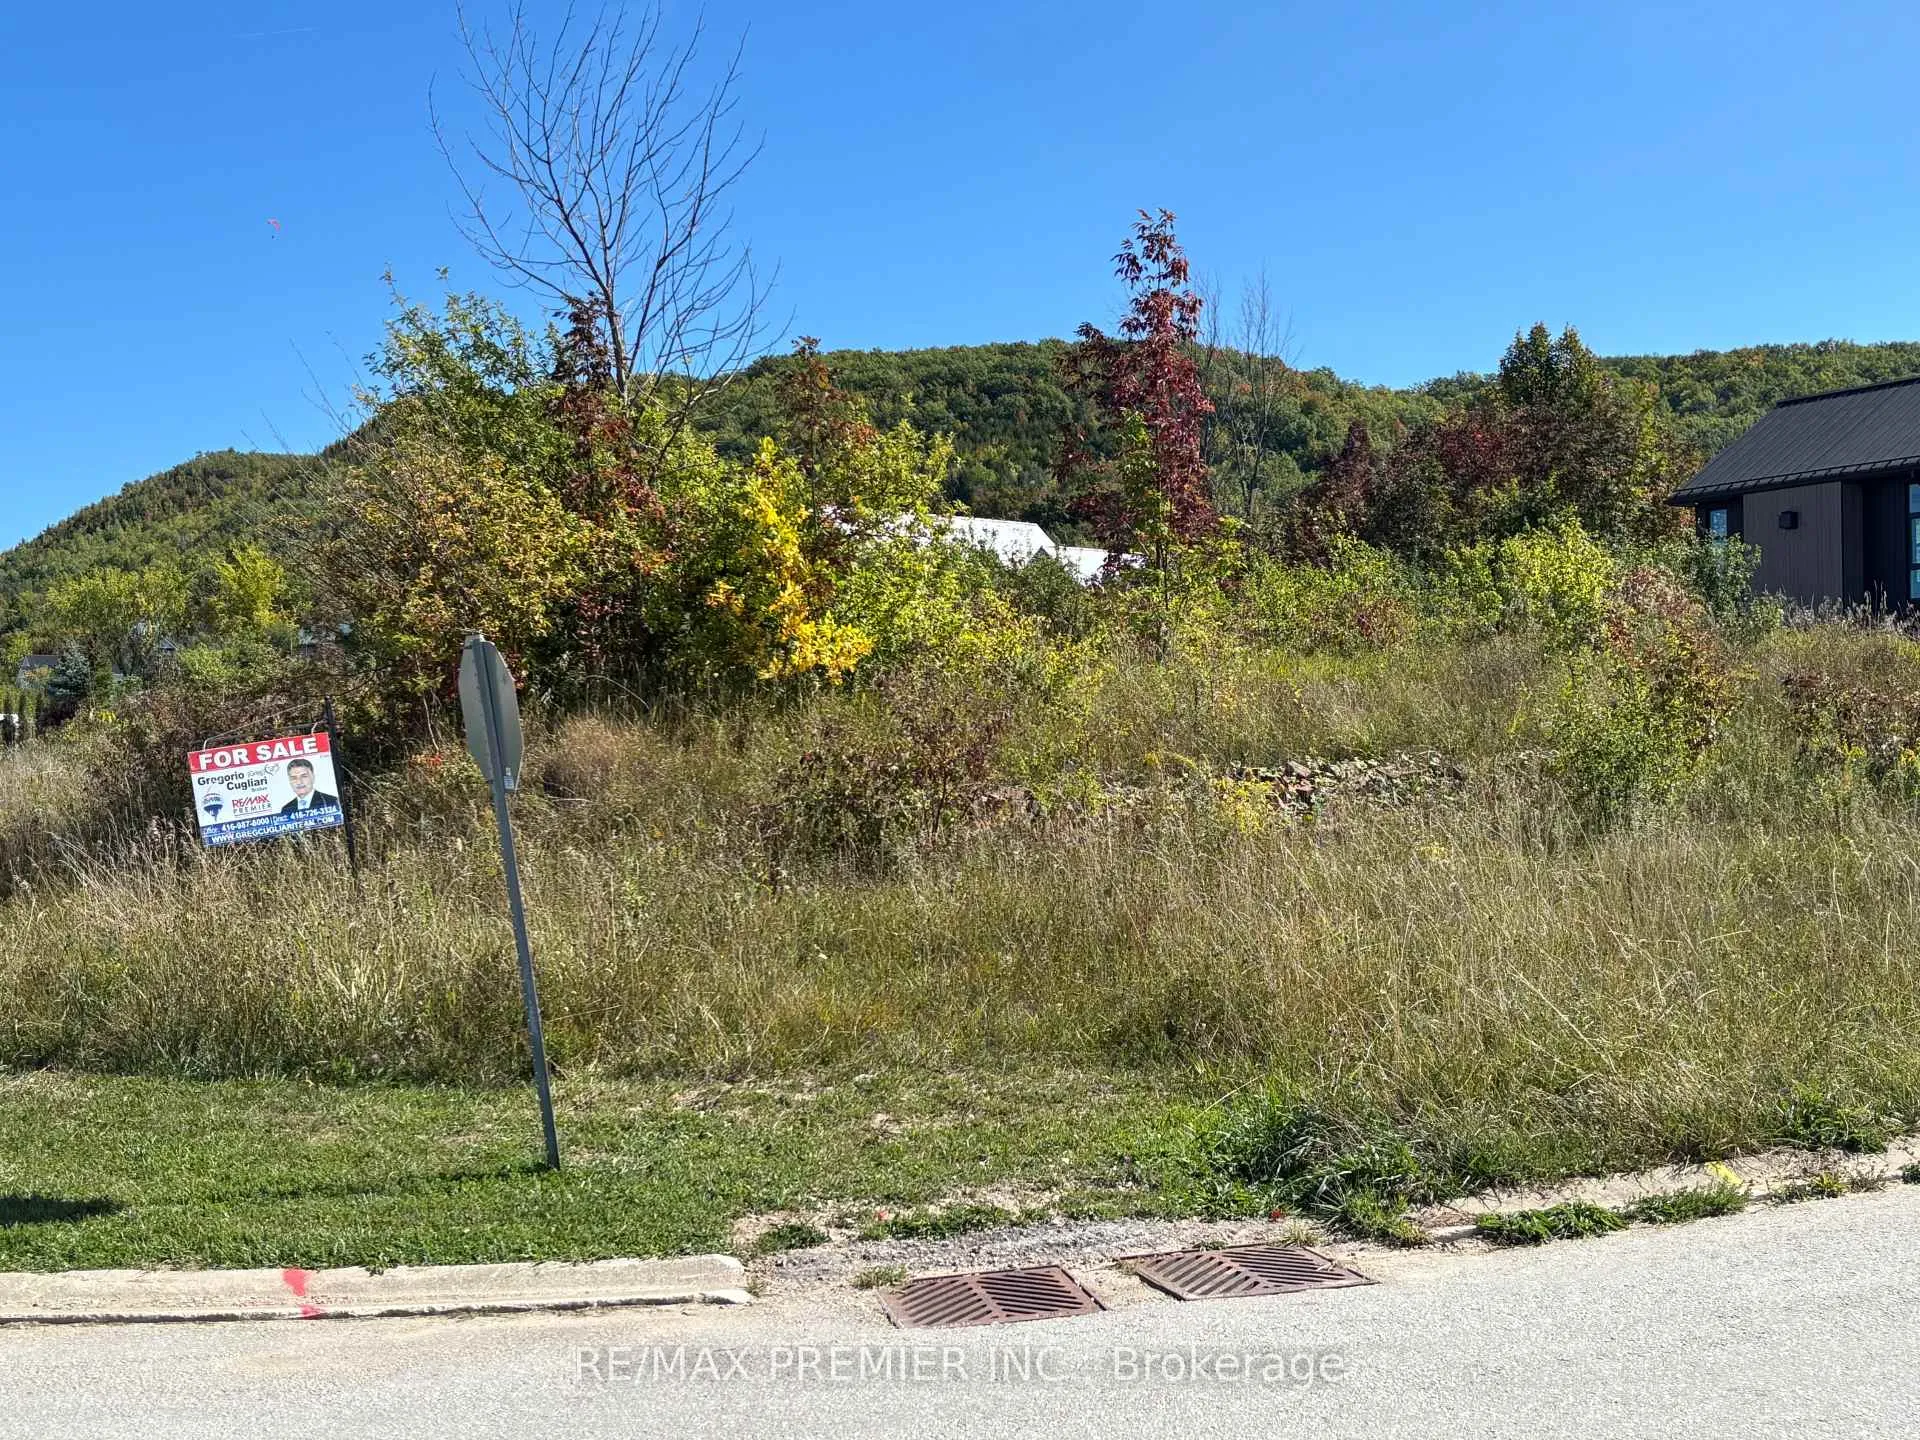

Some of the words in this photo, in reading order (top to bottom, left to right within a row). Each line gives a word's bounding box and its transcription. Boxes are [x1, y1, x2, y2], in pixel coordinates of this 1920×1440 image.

[199, 748, 250, 770] FOR
[256, 737, 318, 761] SALE
[197, 771, 245, 786] Gregorio
[226, 776, 268, 791] Cugliari
[231, 794, 271, 808] RE/MAX
[233, 803, 272, 814] PREMIER
